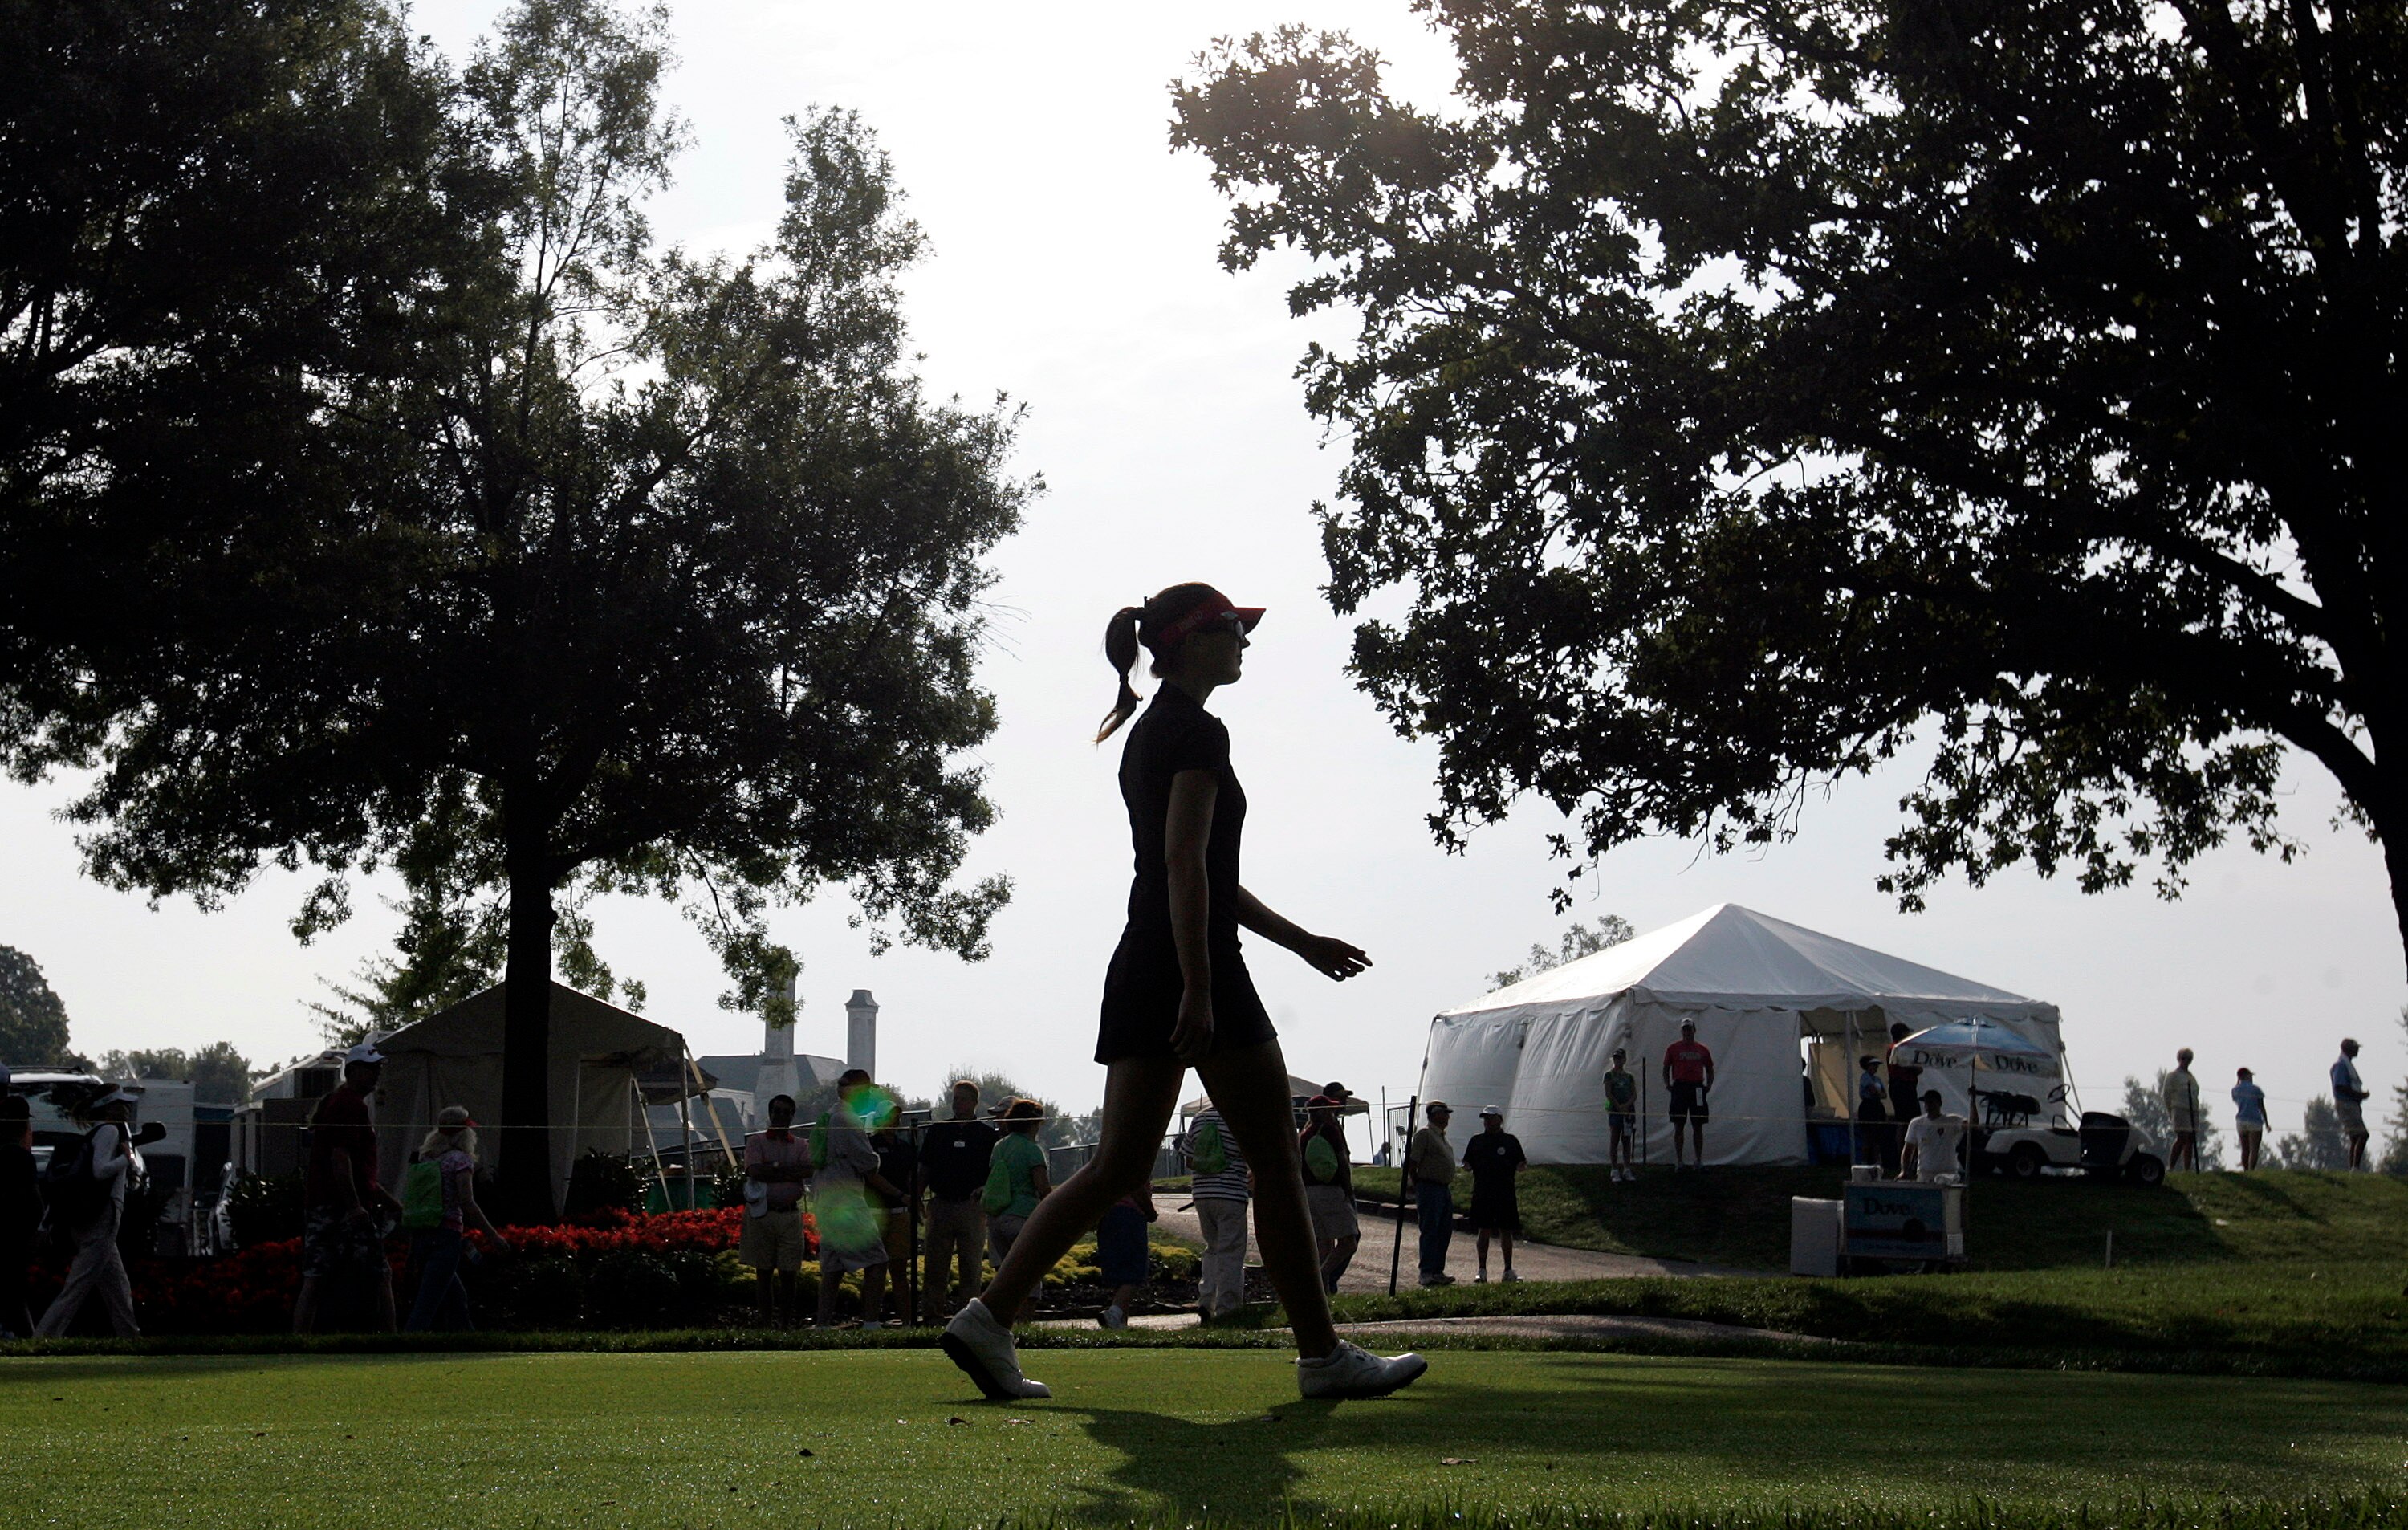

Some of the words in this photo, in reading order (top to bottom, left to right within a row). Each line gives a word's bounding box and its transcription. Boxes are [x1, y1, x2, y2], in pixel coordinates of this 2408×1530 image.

[1912, 1049, 1957, 1068] Dove
[1995, 1055, 2037, 1073] Dove
[1863, 1198, 1910, 1215] Dove
